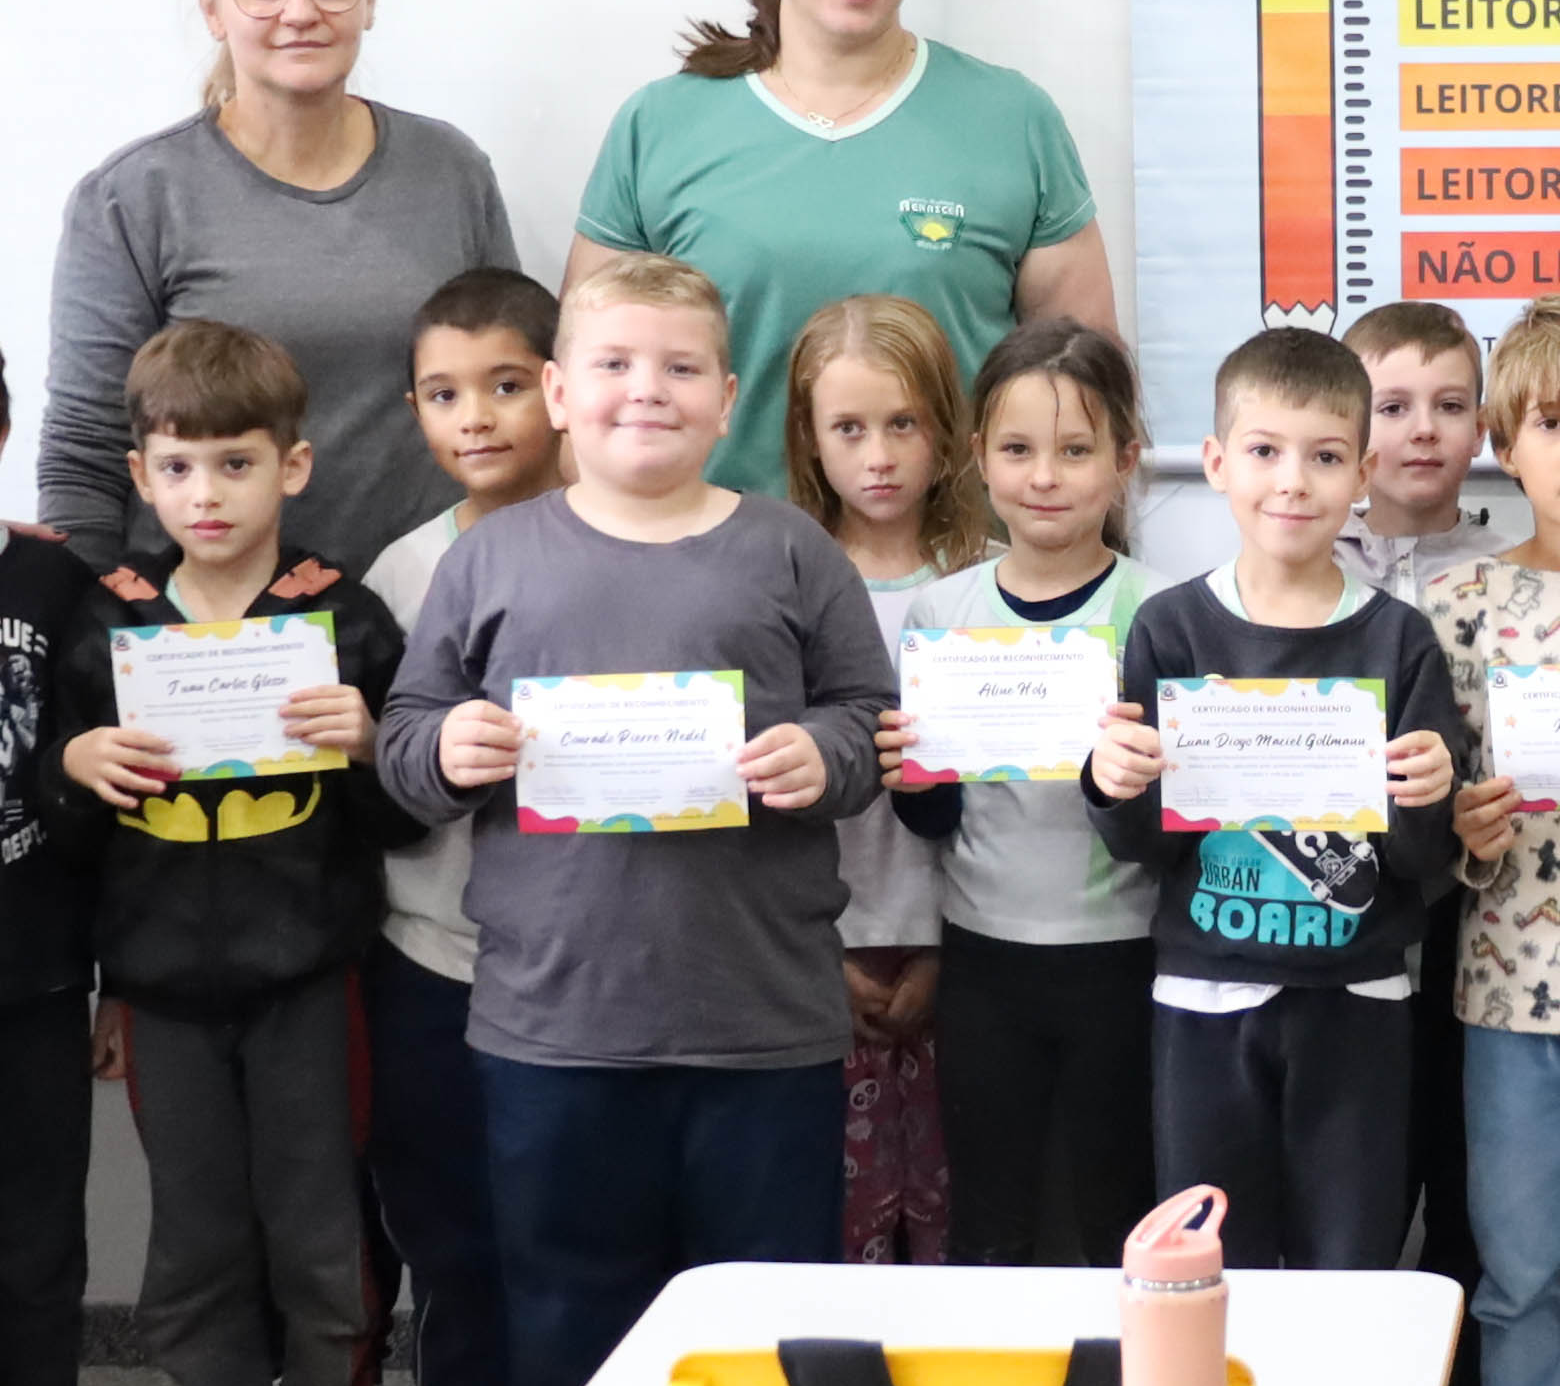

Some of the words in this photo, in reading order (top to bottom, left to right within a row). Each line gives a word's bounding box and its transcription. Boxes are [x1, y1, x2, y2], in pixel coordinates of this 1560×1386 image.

[1417, 242, 1516, 284] NÃO
[1205, 863, 1261, 892] URBAN
[1190, 891, 1361, 947] BOARD
